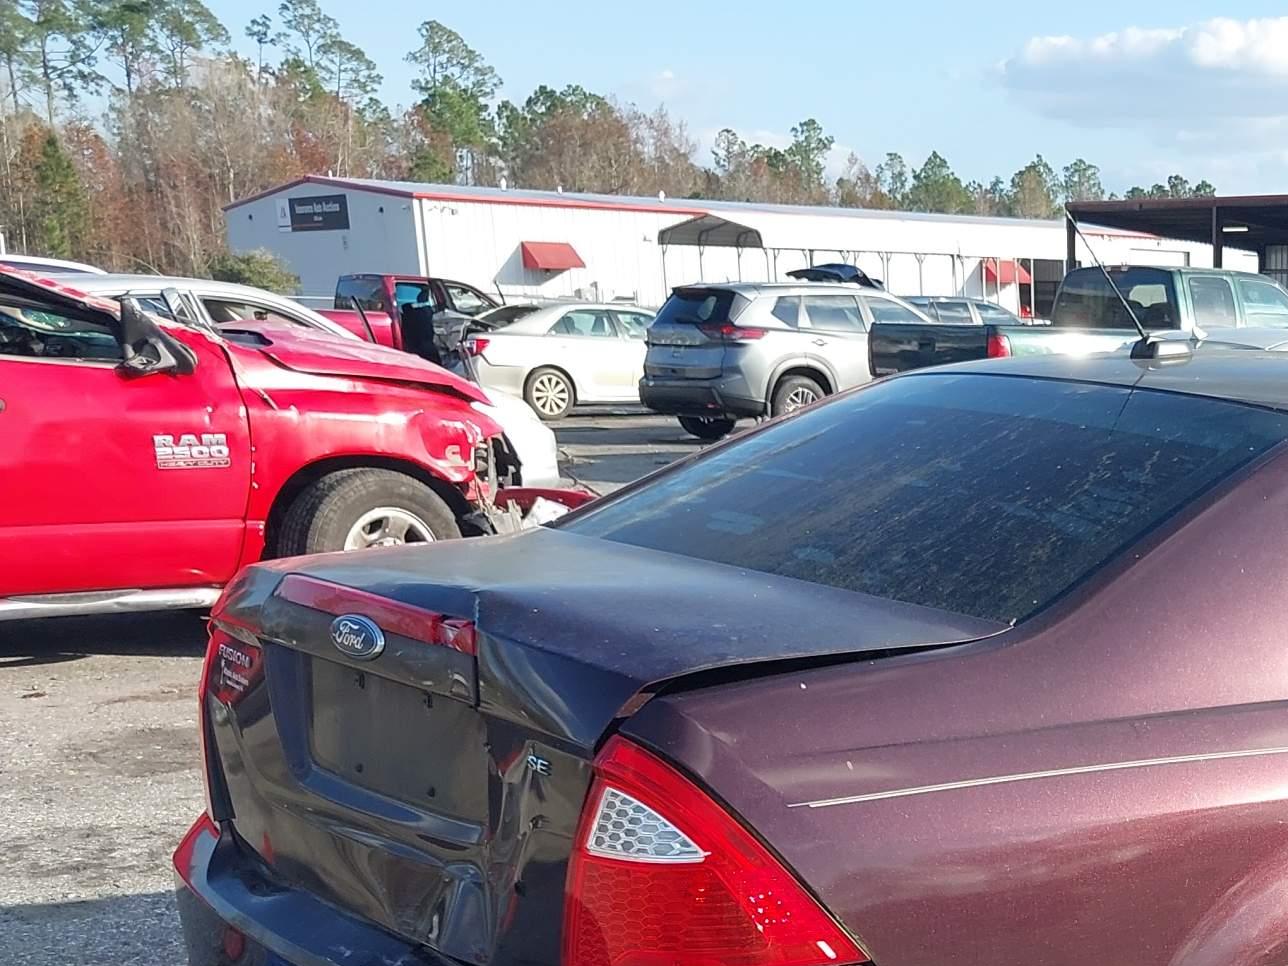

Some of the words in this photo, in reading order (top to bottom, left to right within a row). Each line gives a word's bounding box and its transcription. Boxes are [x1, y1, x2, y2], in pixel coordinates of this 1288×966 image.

[153, 433, 227, 447] RAM
[156, 445, 229, 459] 2500
[332, 620, 366, 650] Ford
[218, 643, 251, 669] FUSION
[527, 755, 550, 776] SE
